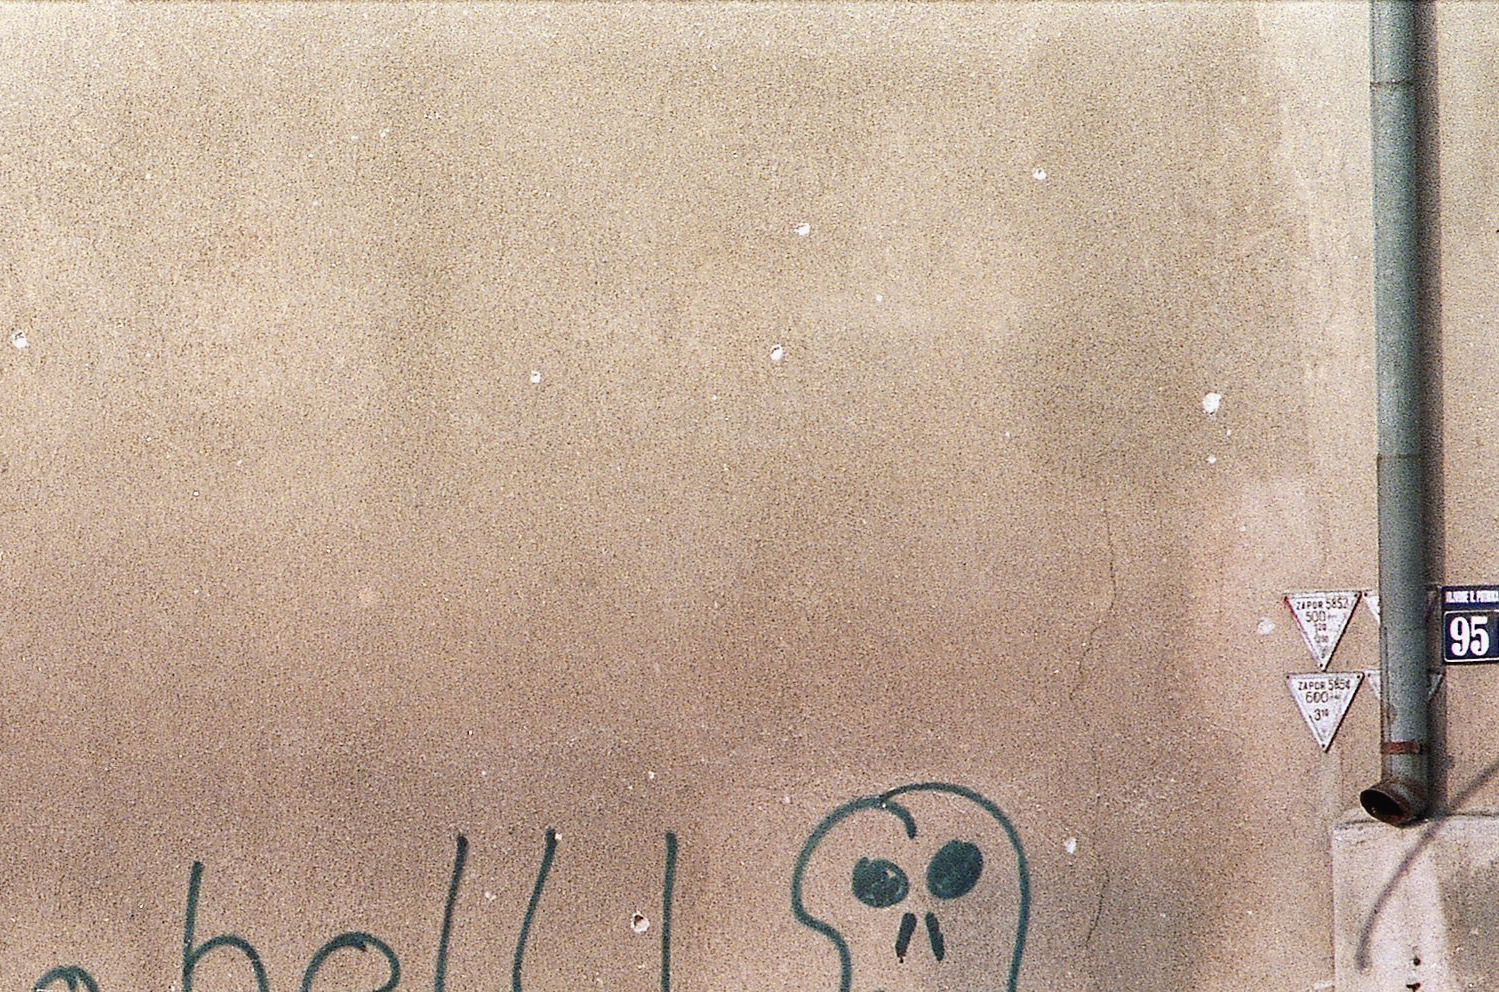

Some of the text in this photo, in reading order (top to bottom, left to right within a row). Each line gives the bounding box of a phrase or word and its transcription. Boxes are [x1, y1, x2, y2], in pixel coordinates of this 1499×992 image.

[1305, 611, 1326, 622] 500
[1449, 616, 1490, 656] 95
[1305, 691, 1329, 703] 600
